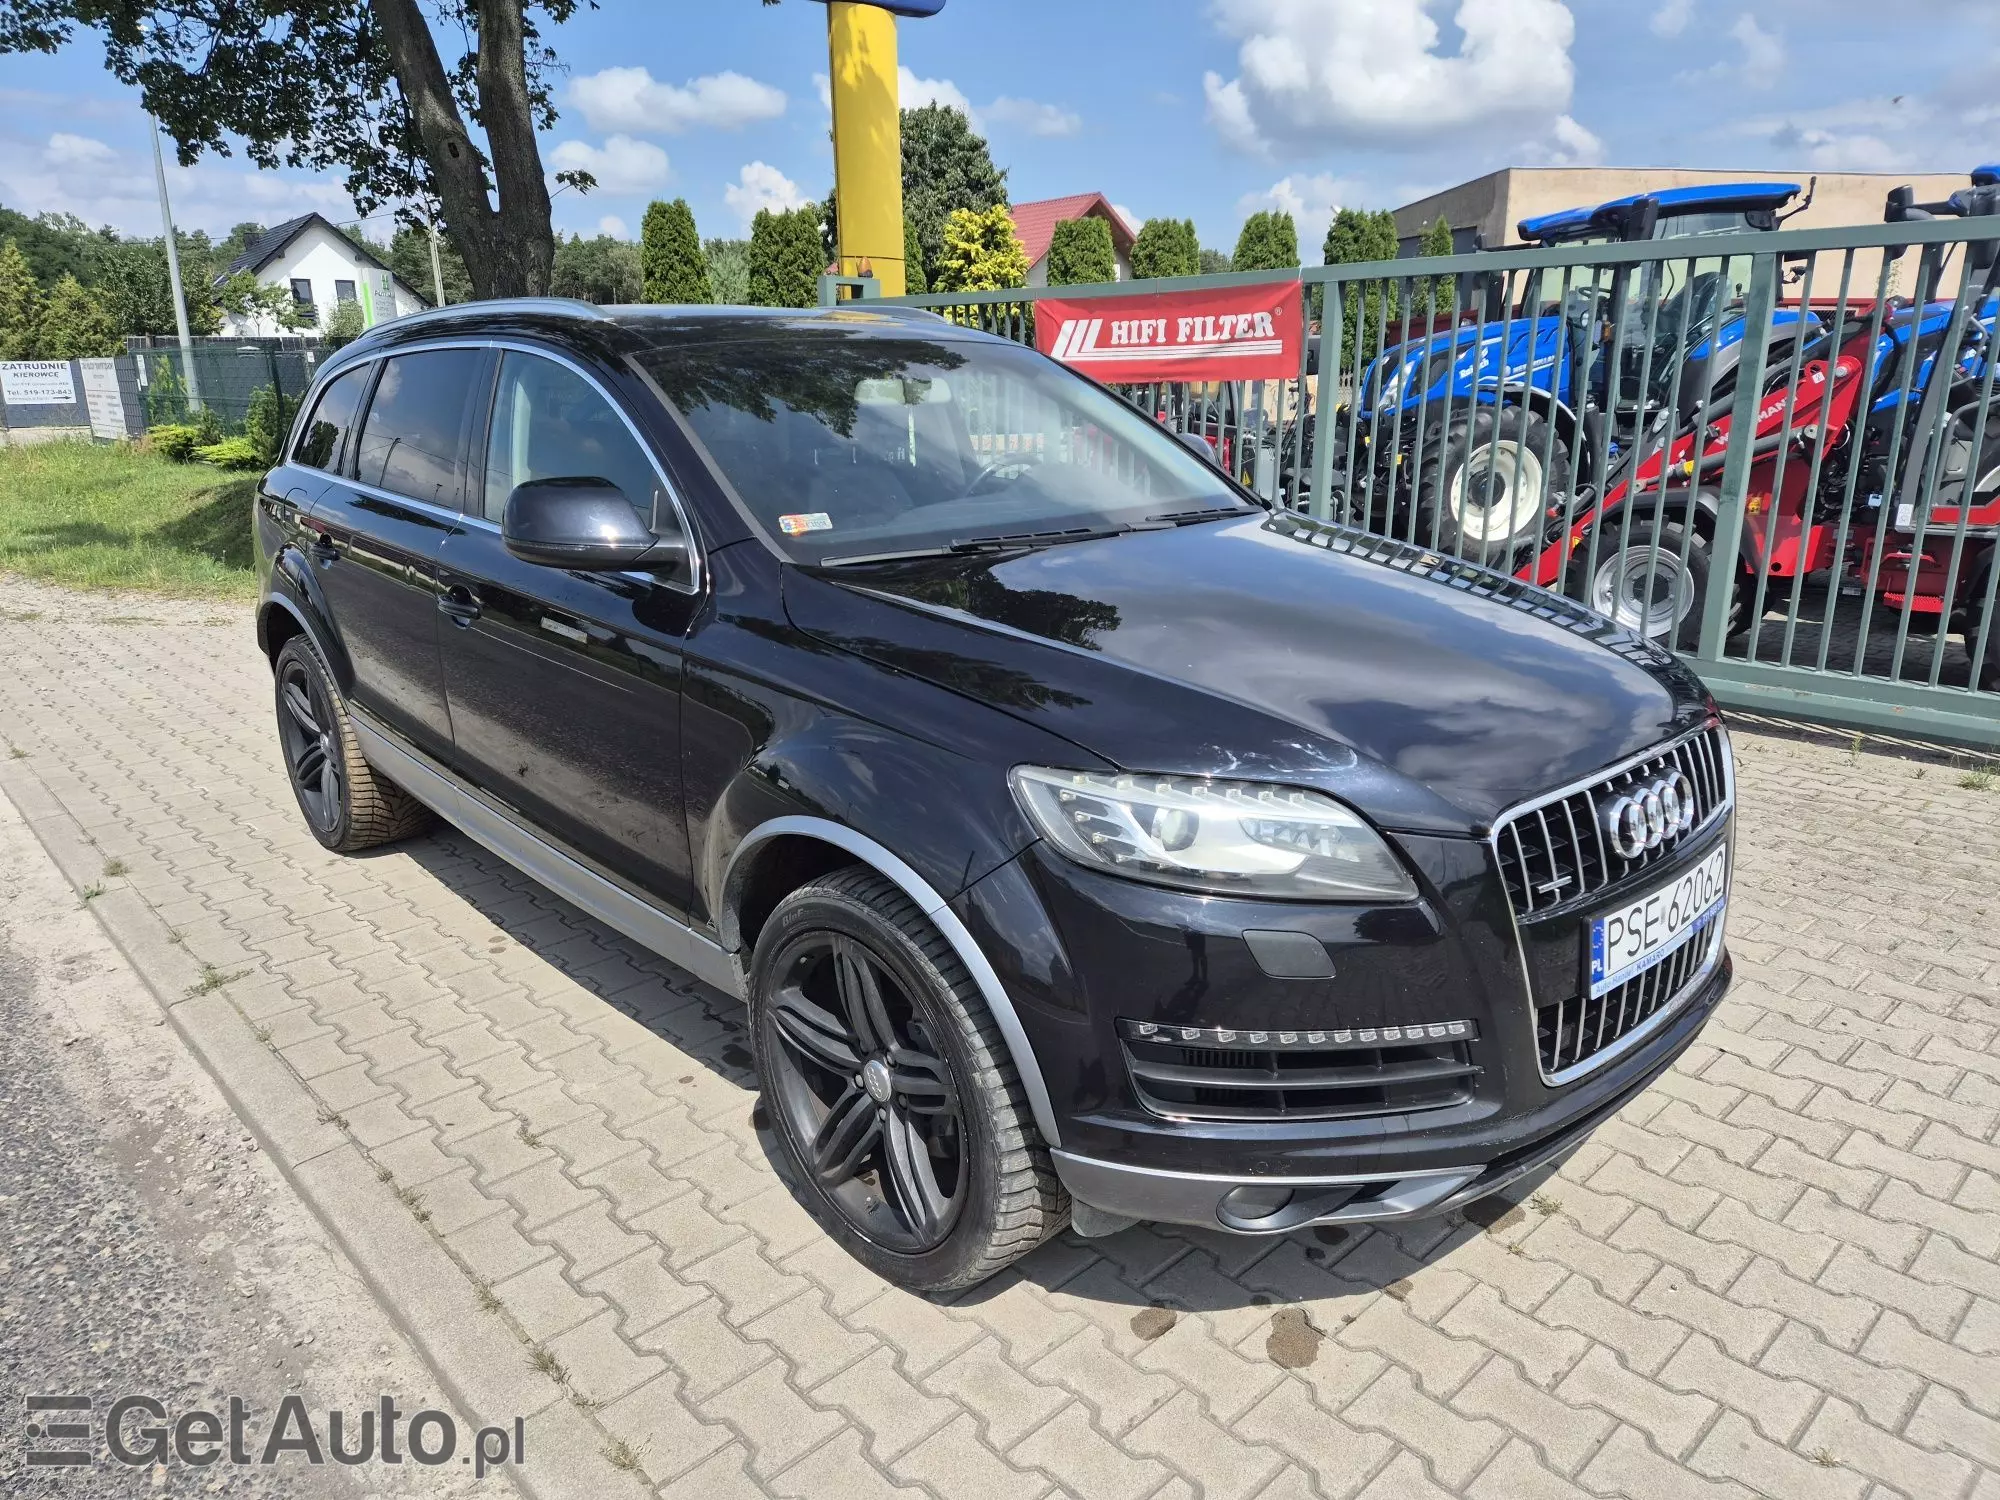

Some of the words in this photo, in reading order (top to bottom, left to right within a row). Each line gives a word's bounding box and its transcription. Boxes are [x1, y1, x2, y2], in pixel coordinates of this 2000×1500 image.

[1110, 318, 1167, 345] HIFI
[1176, 312, 1275, 343] FILTER
[1607, 896, 1660, 971] PSE
[1667, 850, 1724, 933] 62062
[1591, 958, 1603, 975] PL
